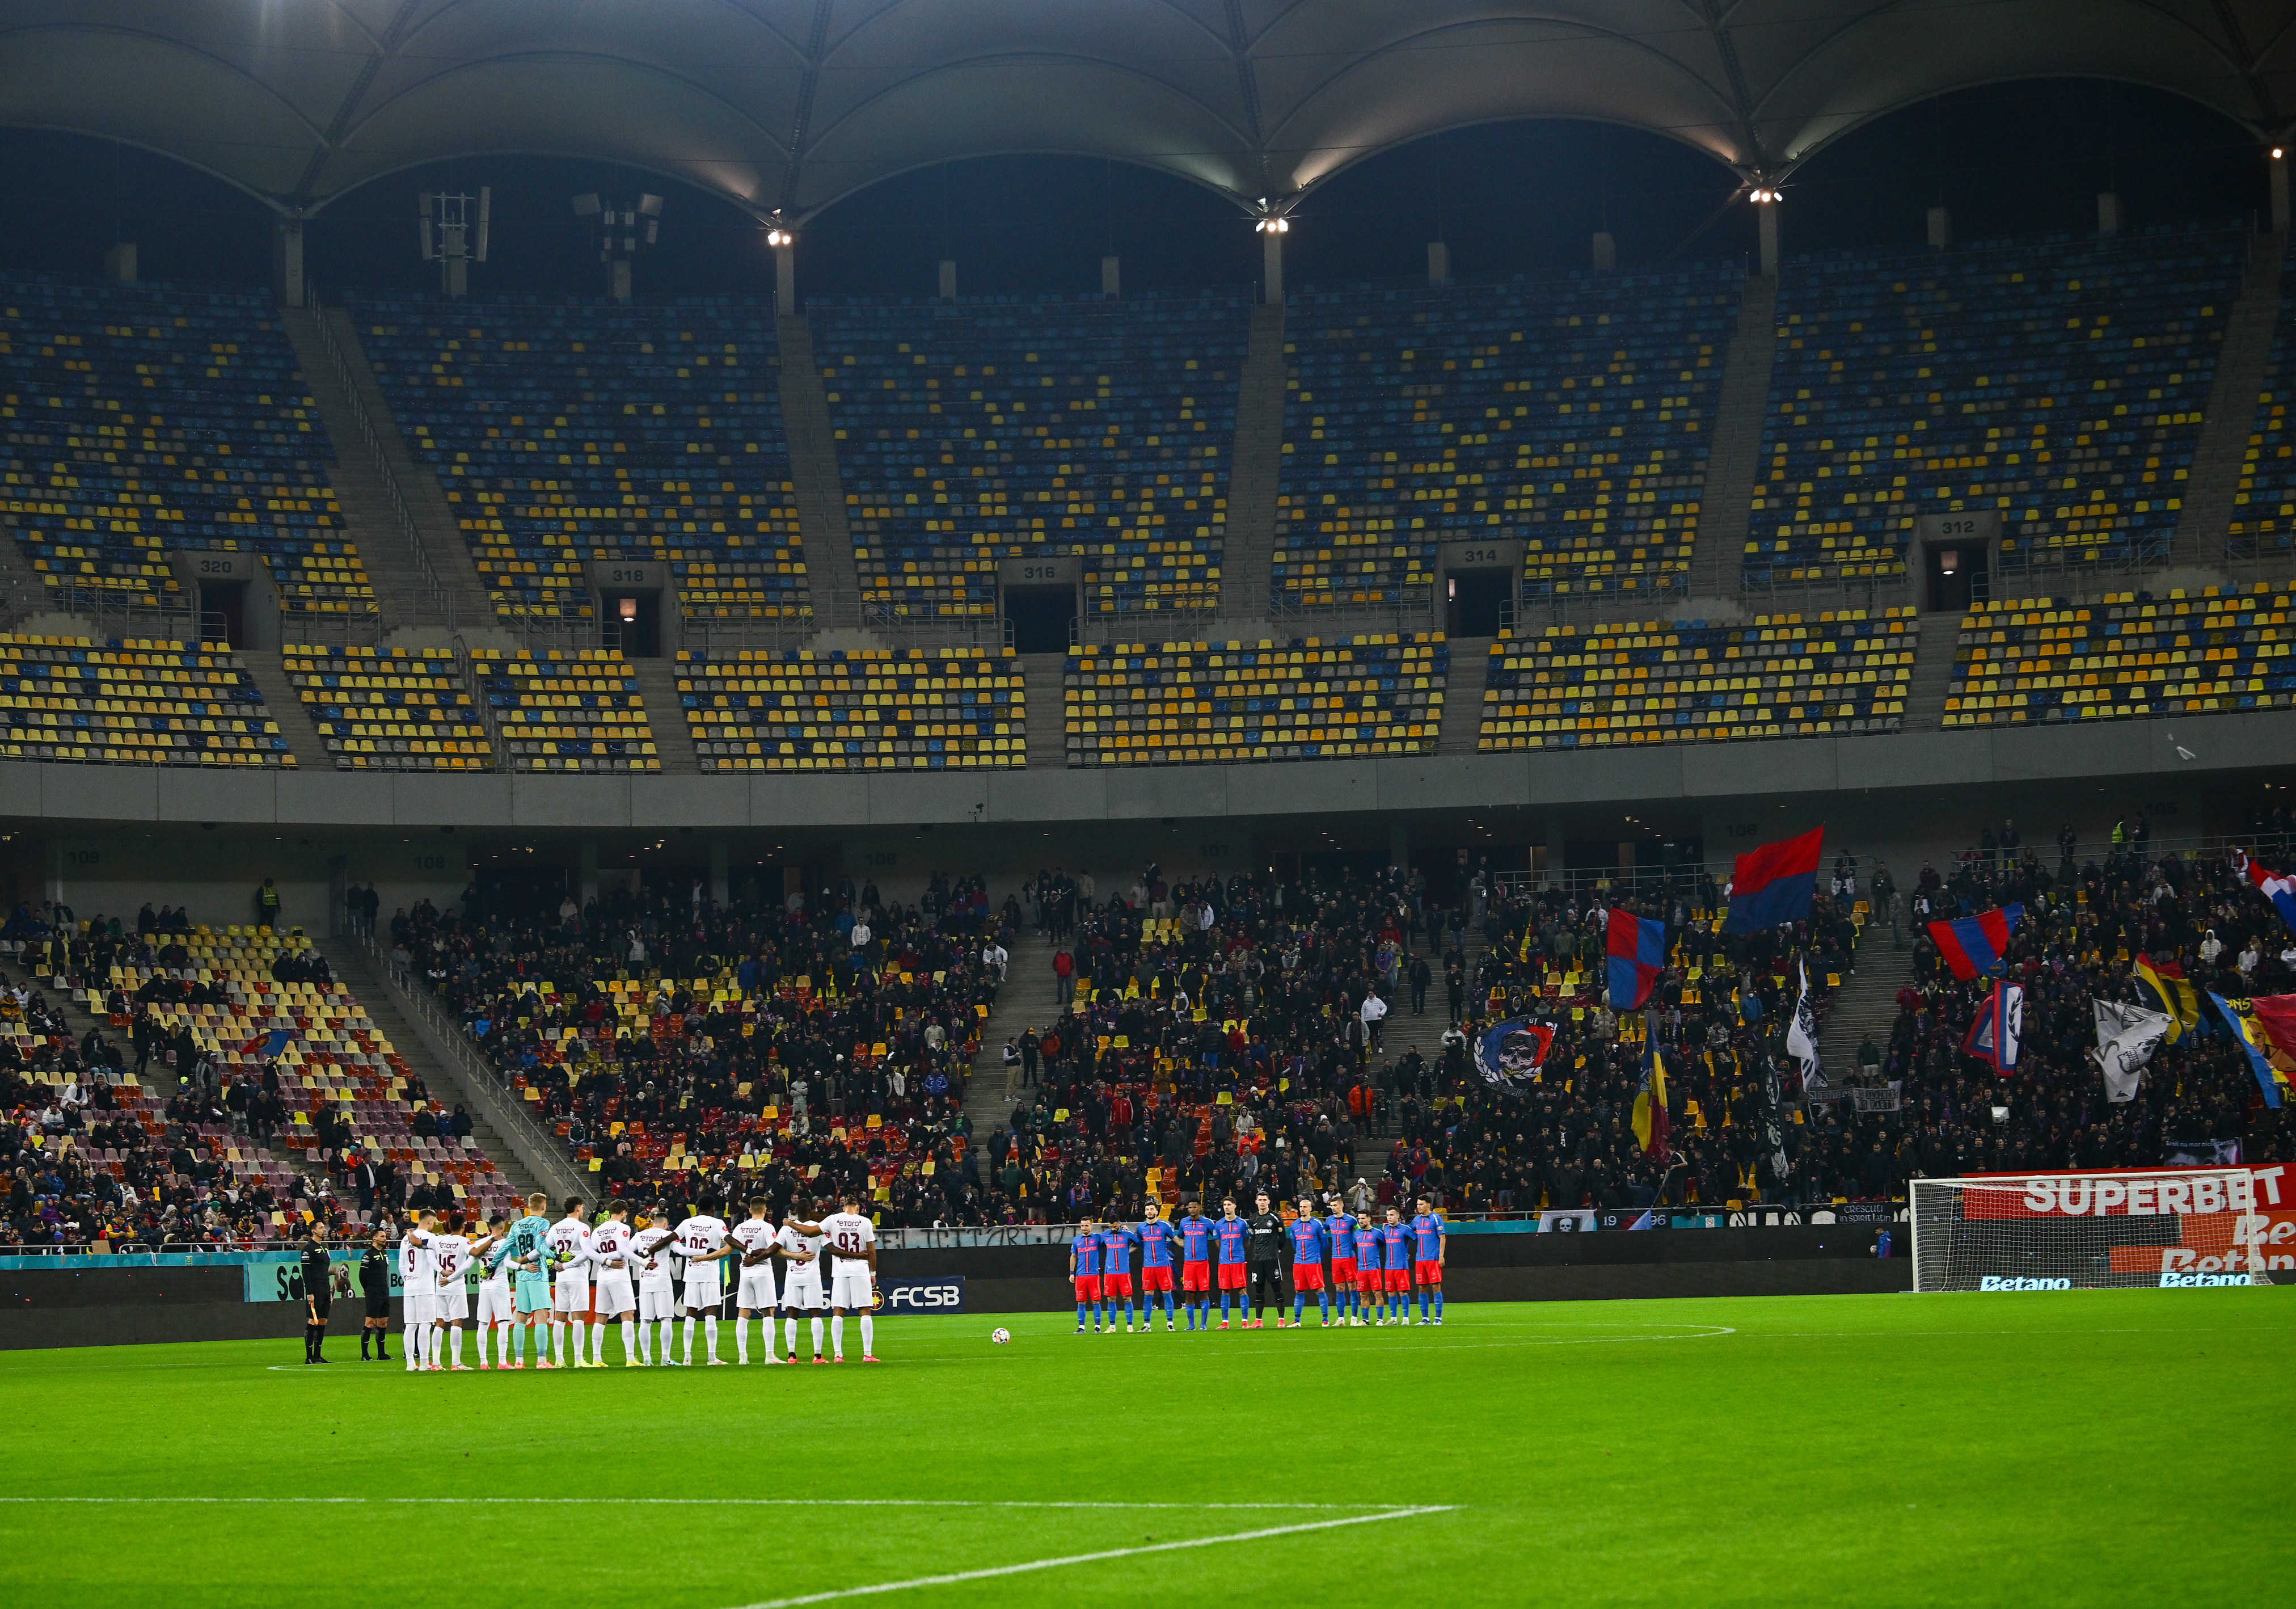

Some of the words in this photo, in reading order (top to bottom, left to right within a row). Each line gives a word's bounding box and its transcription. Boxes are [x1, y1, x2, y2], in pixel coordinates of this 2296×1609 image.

[1943, 521, 1974, 534] 312
[1464, 549, 1496, 562] 314
[201, 560, 232, 573] 320
[1024, 566, 1055, 579] 316
[613, 570, 644, 582] 318
[1199, 844, 1230, 857] 107
[69, 851, 100, 864] 109
[413, 856, 445, 869] 108
[1809, 1089, 1853, 1100] Slashers
[2024, 1166, 2285, 1216] SUPERBET
[1603, 1216, 1617, 1226] 19
[838, 1232, 860, 1254] 93
[408, 1249, 415, 1272] 9
[438, 1253, 457, 1272] 45
[1184, 1280, 1193, 1289] 30
[1980, 1276, 2071, 1291] Betano
[2159, 1273, 2251, 1287] Betano
[889, 1286, 960, 1307] FCSB
